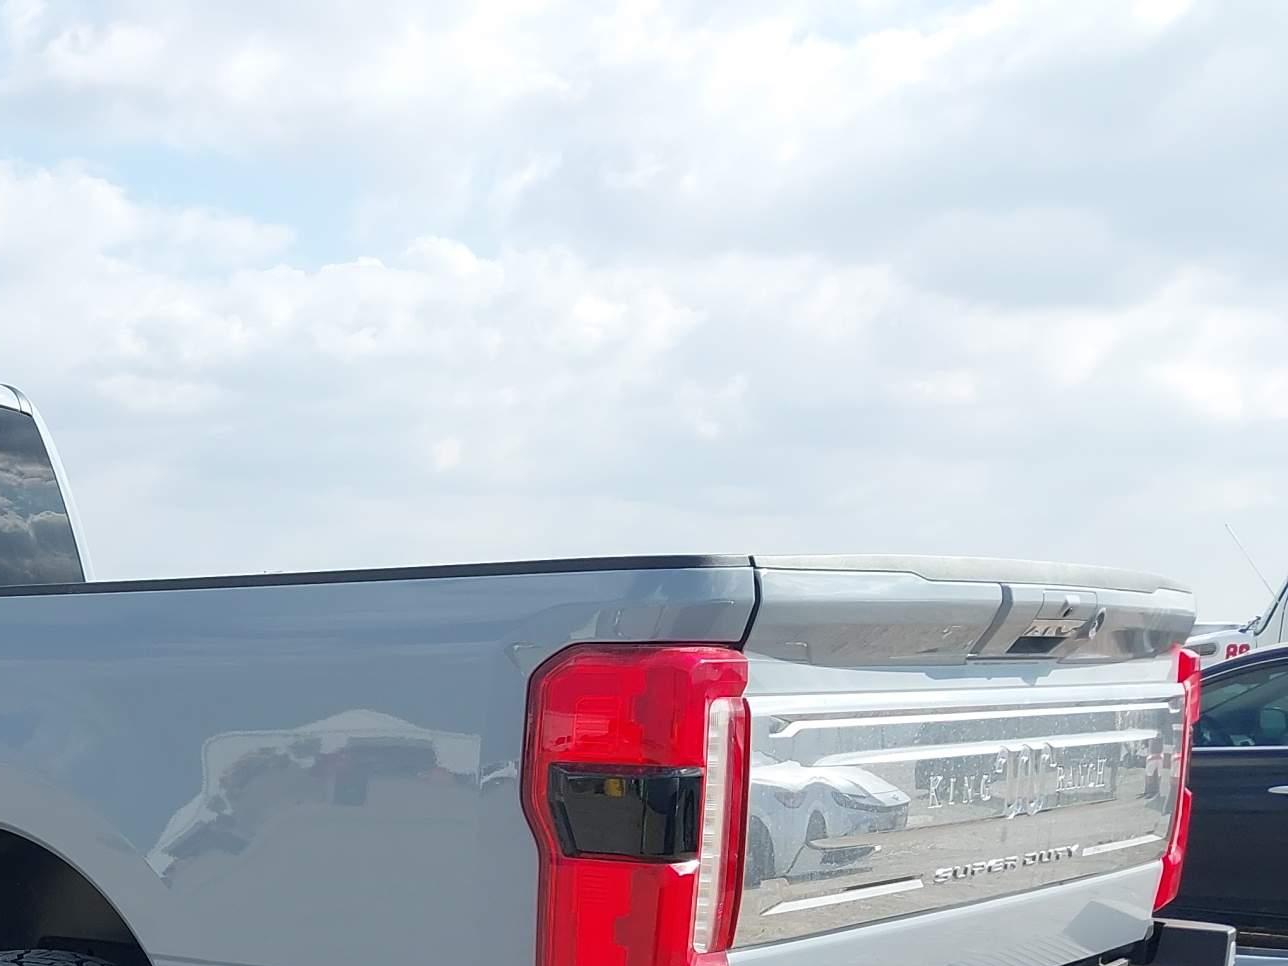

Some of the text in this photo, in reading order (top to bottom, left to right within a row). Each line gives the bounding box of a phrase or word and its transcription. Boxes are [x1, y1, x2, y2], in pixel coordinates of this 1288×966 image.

[927, 757, 1108, 809] KING RANCH
[933, 844, 1080, 884] SUPER DUTY
